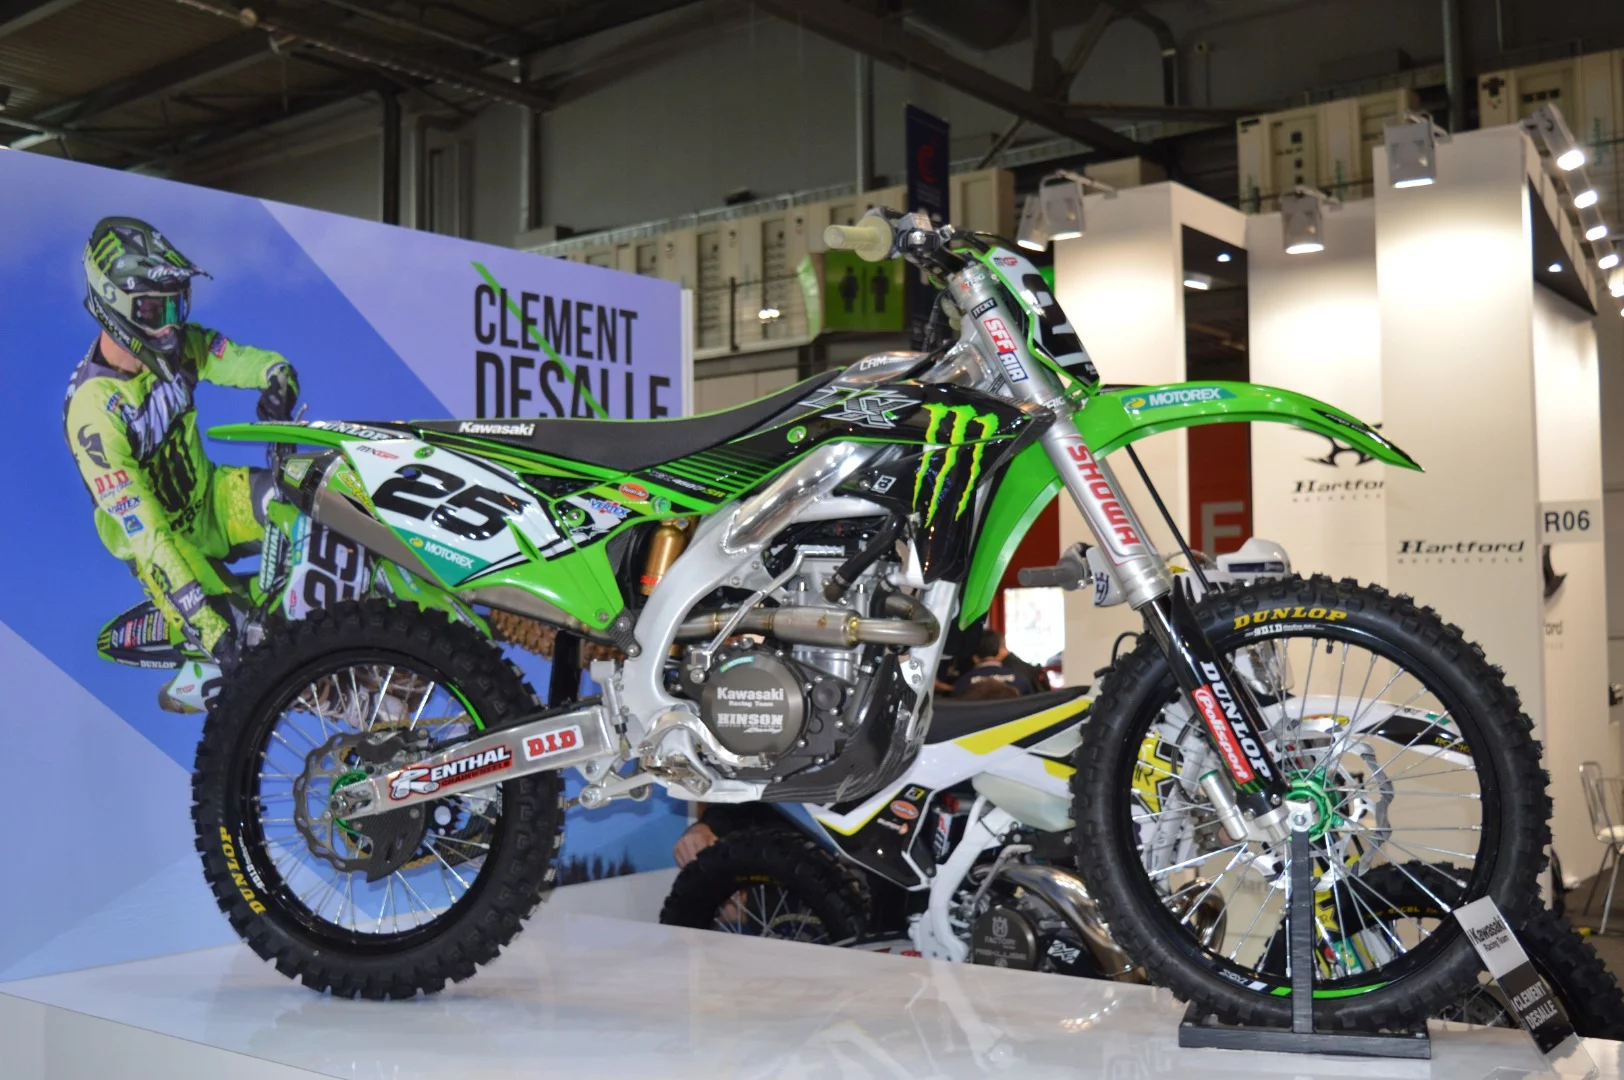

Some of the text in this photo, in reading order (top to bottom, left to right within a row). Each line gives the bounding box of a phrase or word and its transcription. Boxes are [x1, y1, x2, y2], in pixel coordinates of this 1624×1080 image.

[474, 283, 638, 366] CLEMENT
[985, 319, 1017, 354] SFF
[1149, 388, 1221, 406] MOTOREX
[459, 421, 536, 436] Kawasaki
[371, 463, 531, 541] 25
[590, 499, 628, 518] VERTEX
[1067, 445, 1140, 545] SHOWA
[1544, 510, 1590, 532] R06
[424, 541, 476, 569] MOTOREX
[1397, 540, 1524, 554] Hartford
[1233, 606, 1348, 630] DUNLOP
[717, 687, 784, 700] Kawasaki
[717, 713, 784, 725] HINSON
[1200, 661, 1271, 777] DUNLOP
[1196, 694, 1249, 779] Polisport
[220, 826, 266, 915] DUNLOP
[1472, 916, 1507, 944] Kawasaki
[1483, 934, 1510, 953] Racing Team
[1514, 981, 1547, 1013] CLEMENT
[1525, 1000, 1558, 1031] DESALLE
